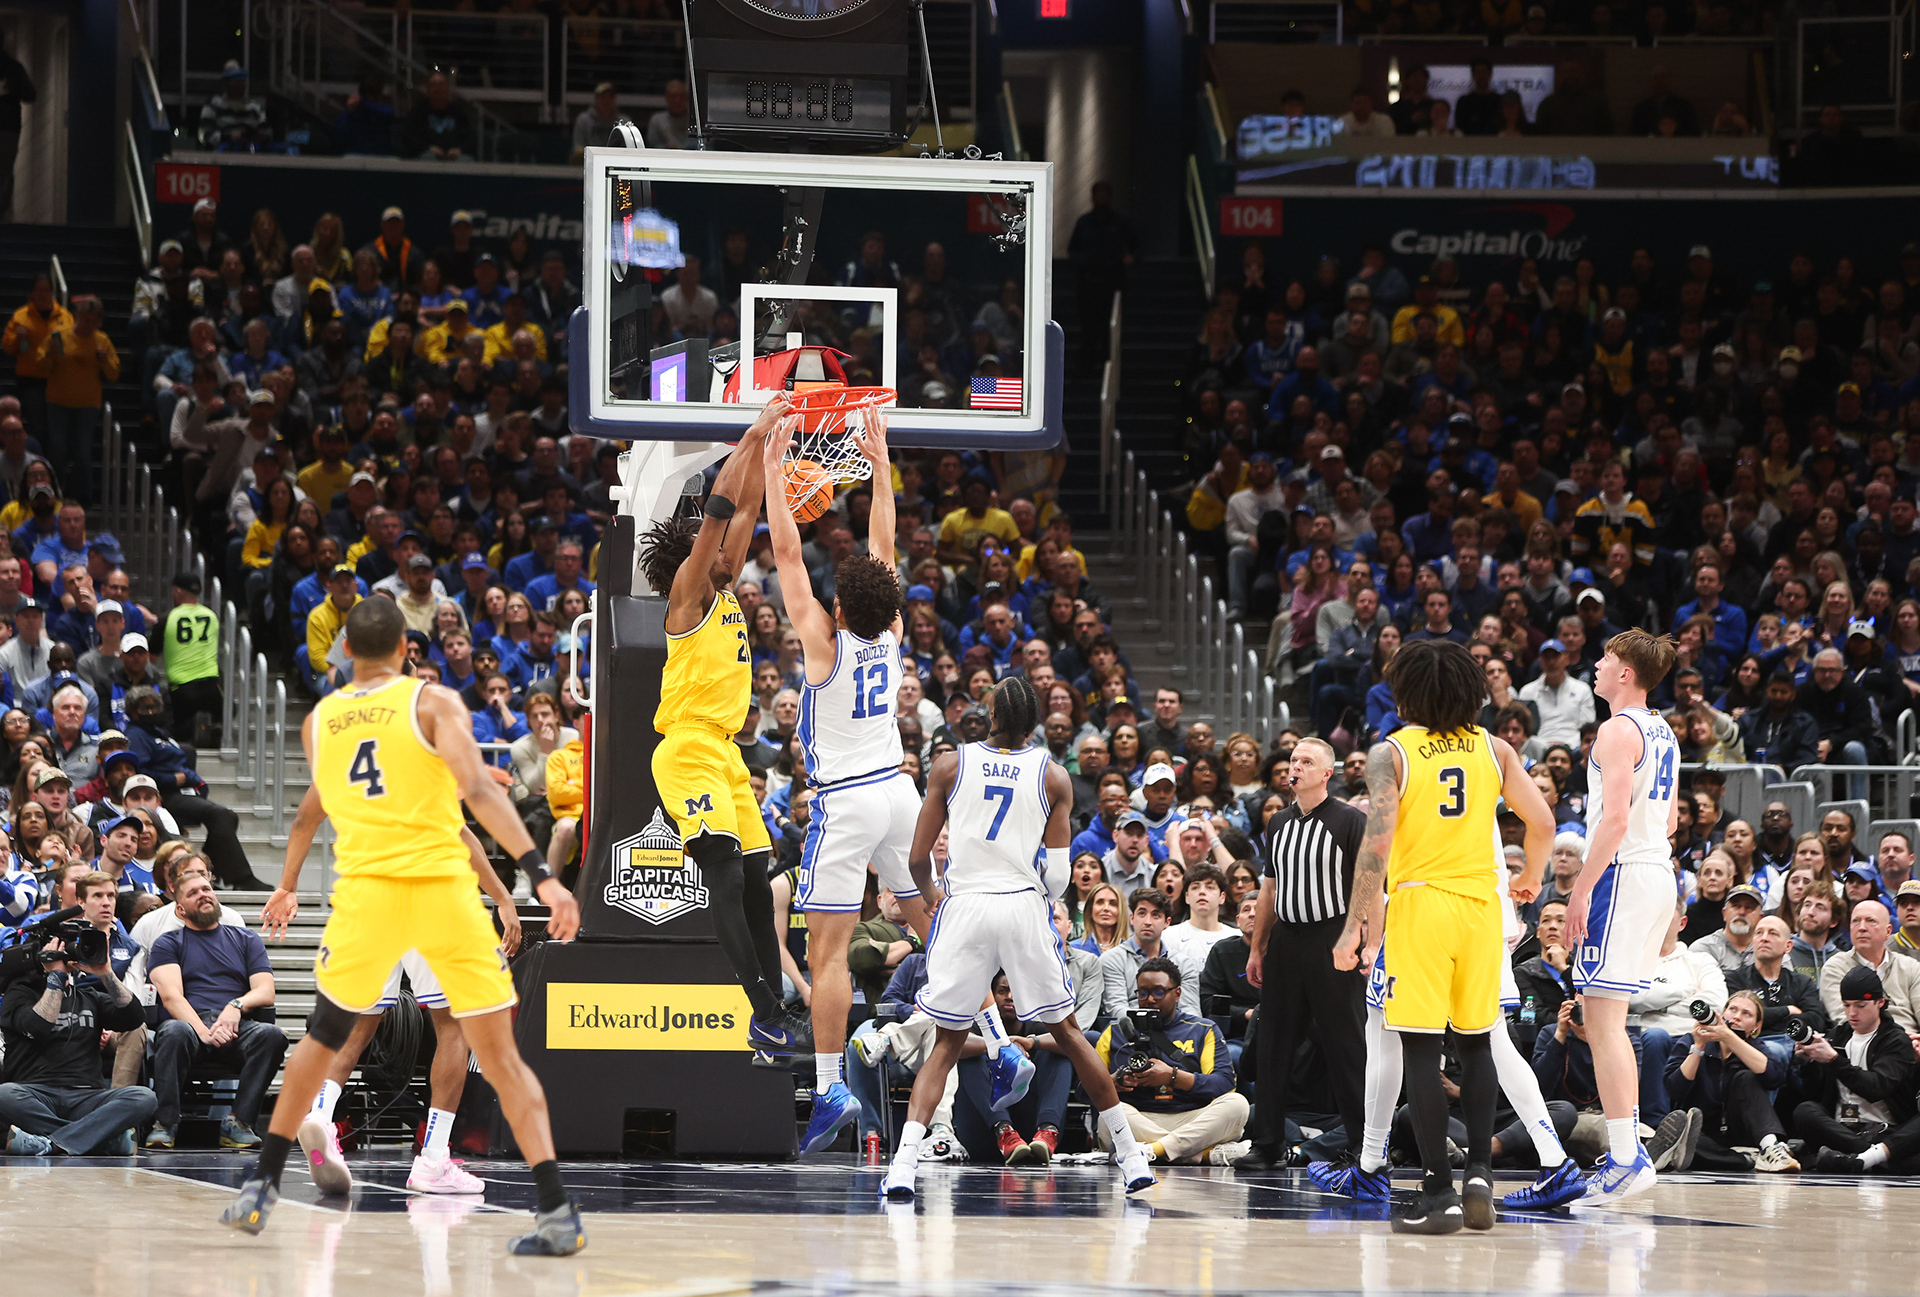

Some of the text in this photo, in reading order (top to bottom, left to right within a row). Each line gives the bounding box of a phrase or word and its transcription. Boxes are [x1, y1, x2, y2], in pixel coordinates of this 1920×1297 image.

[166, 172, 211, 196] 105
[1230, 207, 1274, 229] 104
[176, 616, 211, 644] 67
[851, 662, 888, 719] 12
[327, 706, 397, 736] BURNETT
[1418, 738, 1475, 760] CADEAU
[347, 738, 386, 798] 4
[982, 762, 1021, 781] SARR
[1648, 745, 1674, 801] 14
[1438, 766, 1466, 818] 3
[684, 793, 714, 816] M
[983, 785, 1014, 841] 7
[619, 868, 695, 887] CAPITAL
[607, 884, 707, 905] SHOWCASE
[1583, 945, 1601, 963] D
